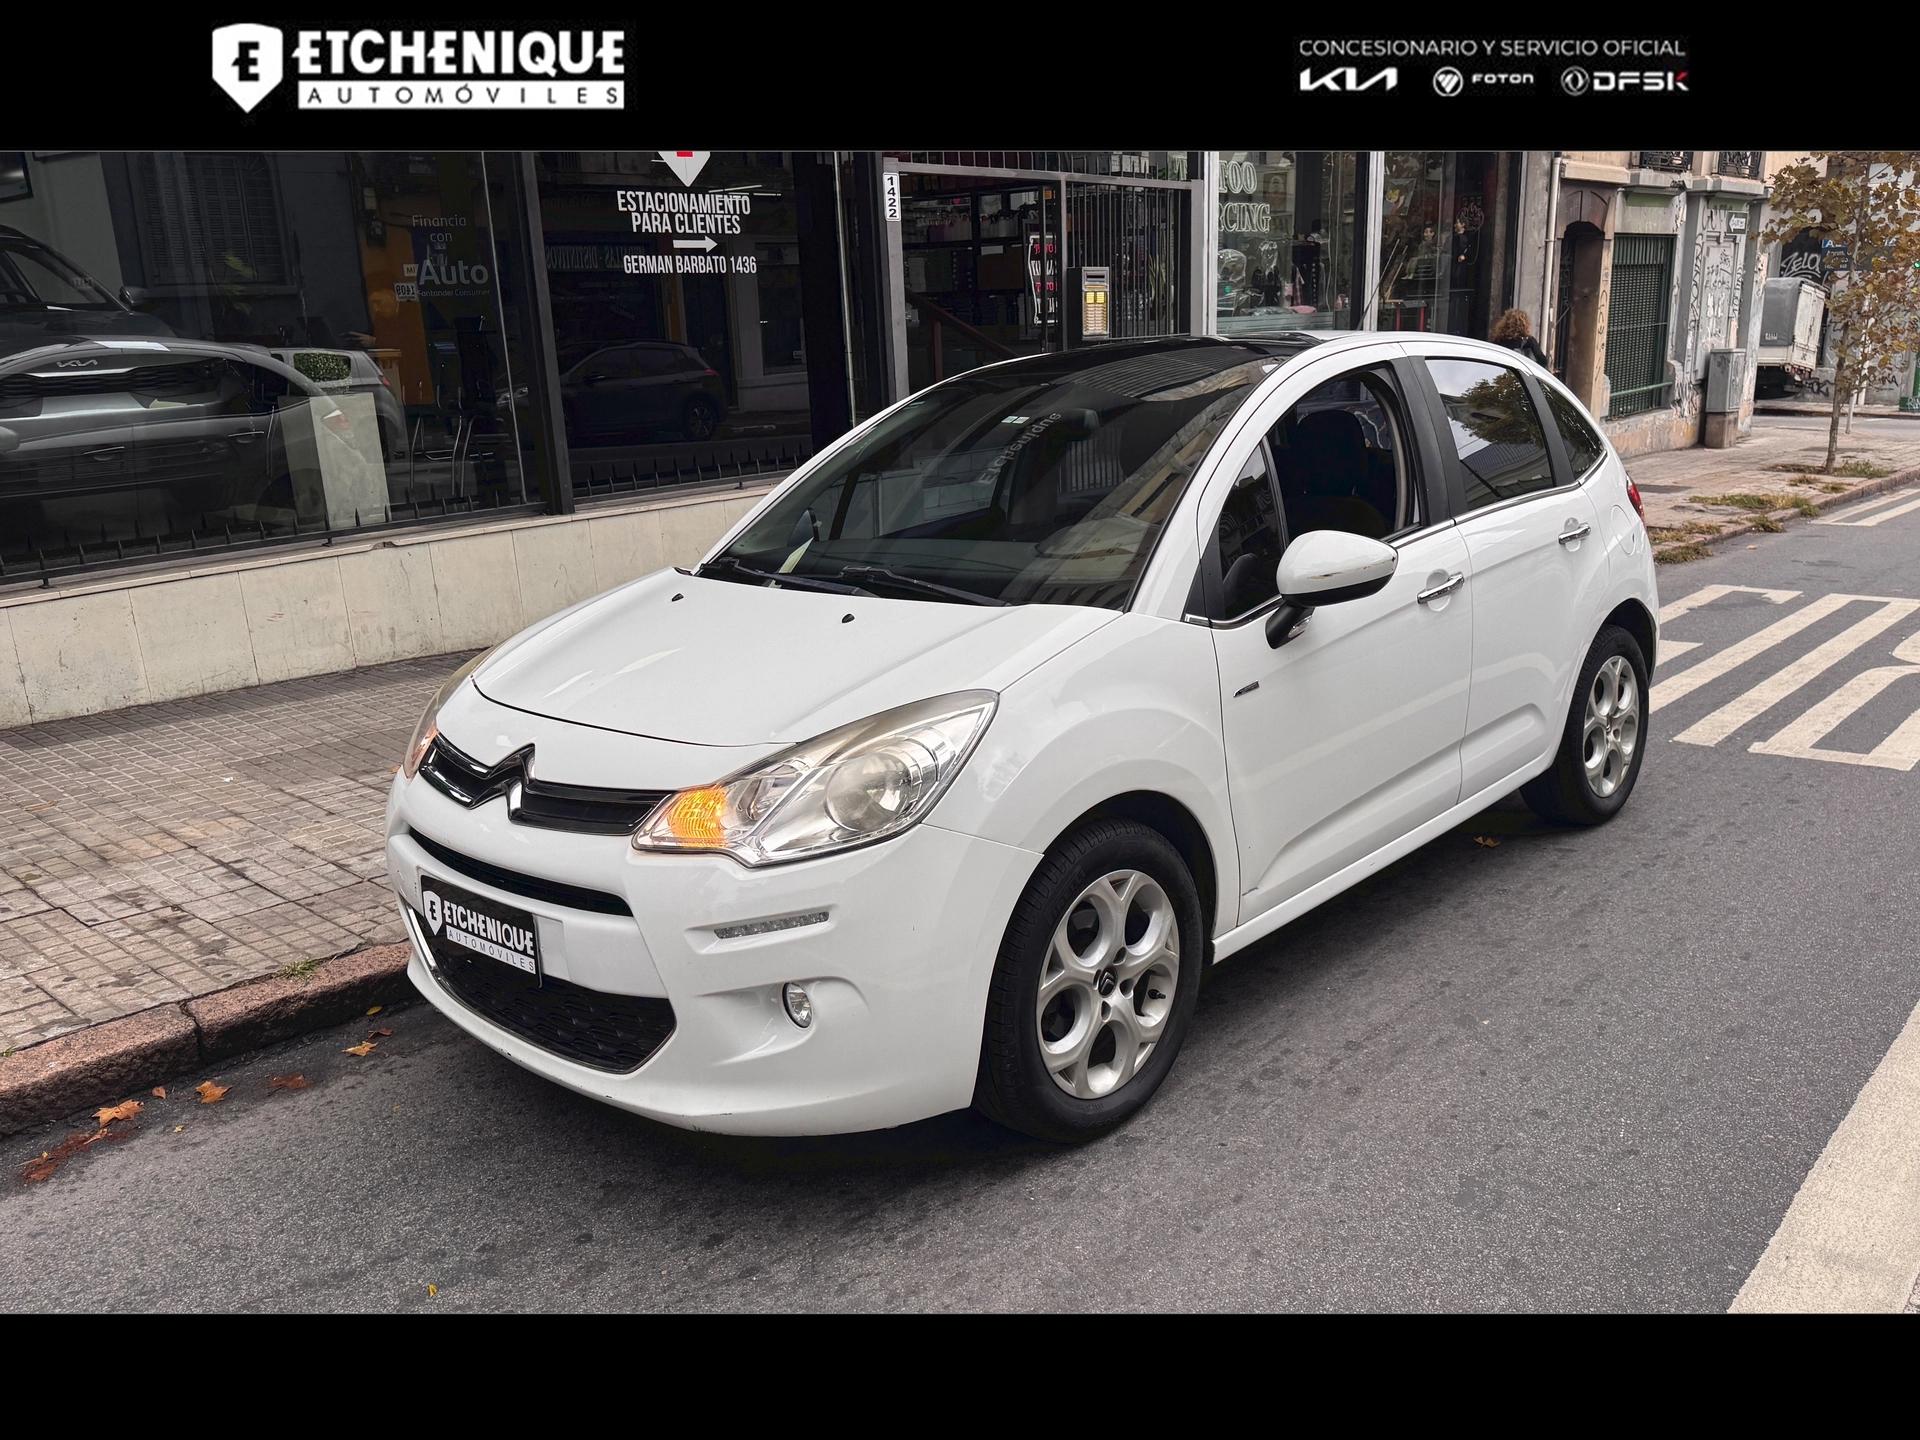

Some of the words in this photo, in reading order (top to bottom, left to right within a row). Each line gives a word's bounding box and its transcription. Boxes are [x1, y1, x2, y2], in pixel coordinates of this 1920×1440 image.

[616, 191, 751, 215] ESTACIONAMIENTO
[886, 176, 898, 218] 1422
[412, 214, 467, 227] Financia
[631, 212, 672, 233] PARA
[675, 213, 741, 235] CLIENTES
[429, 232, 453, 243] con
[418, 259, 489, 286] Auto
[623, 255, 674, 274] GERMAN
[676, 255, 727, 274] BARBATO
[730, 255, 757, 274] 1436
[417, 289, 454, 298] Santander
[455, 289, 490, 297] Consumer
[443, 900, 535, 956] ETCHENIQUE
[448, 929, 535, 972] AUTOMÓVILES
